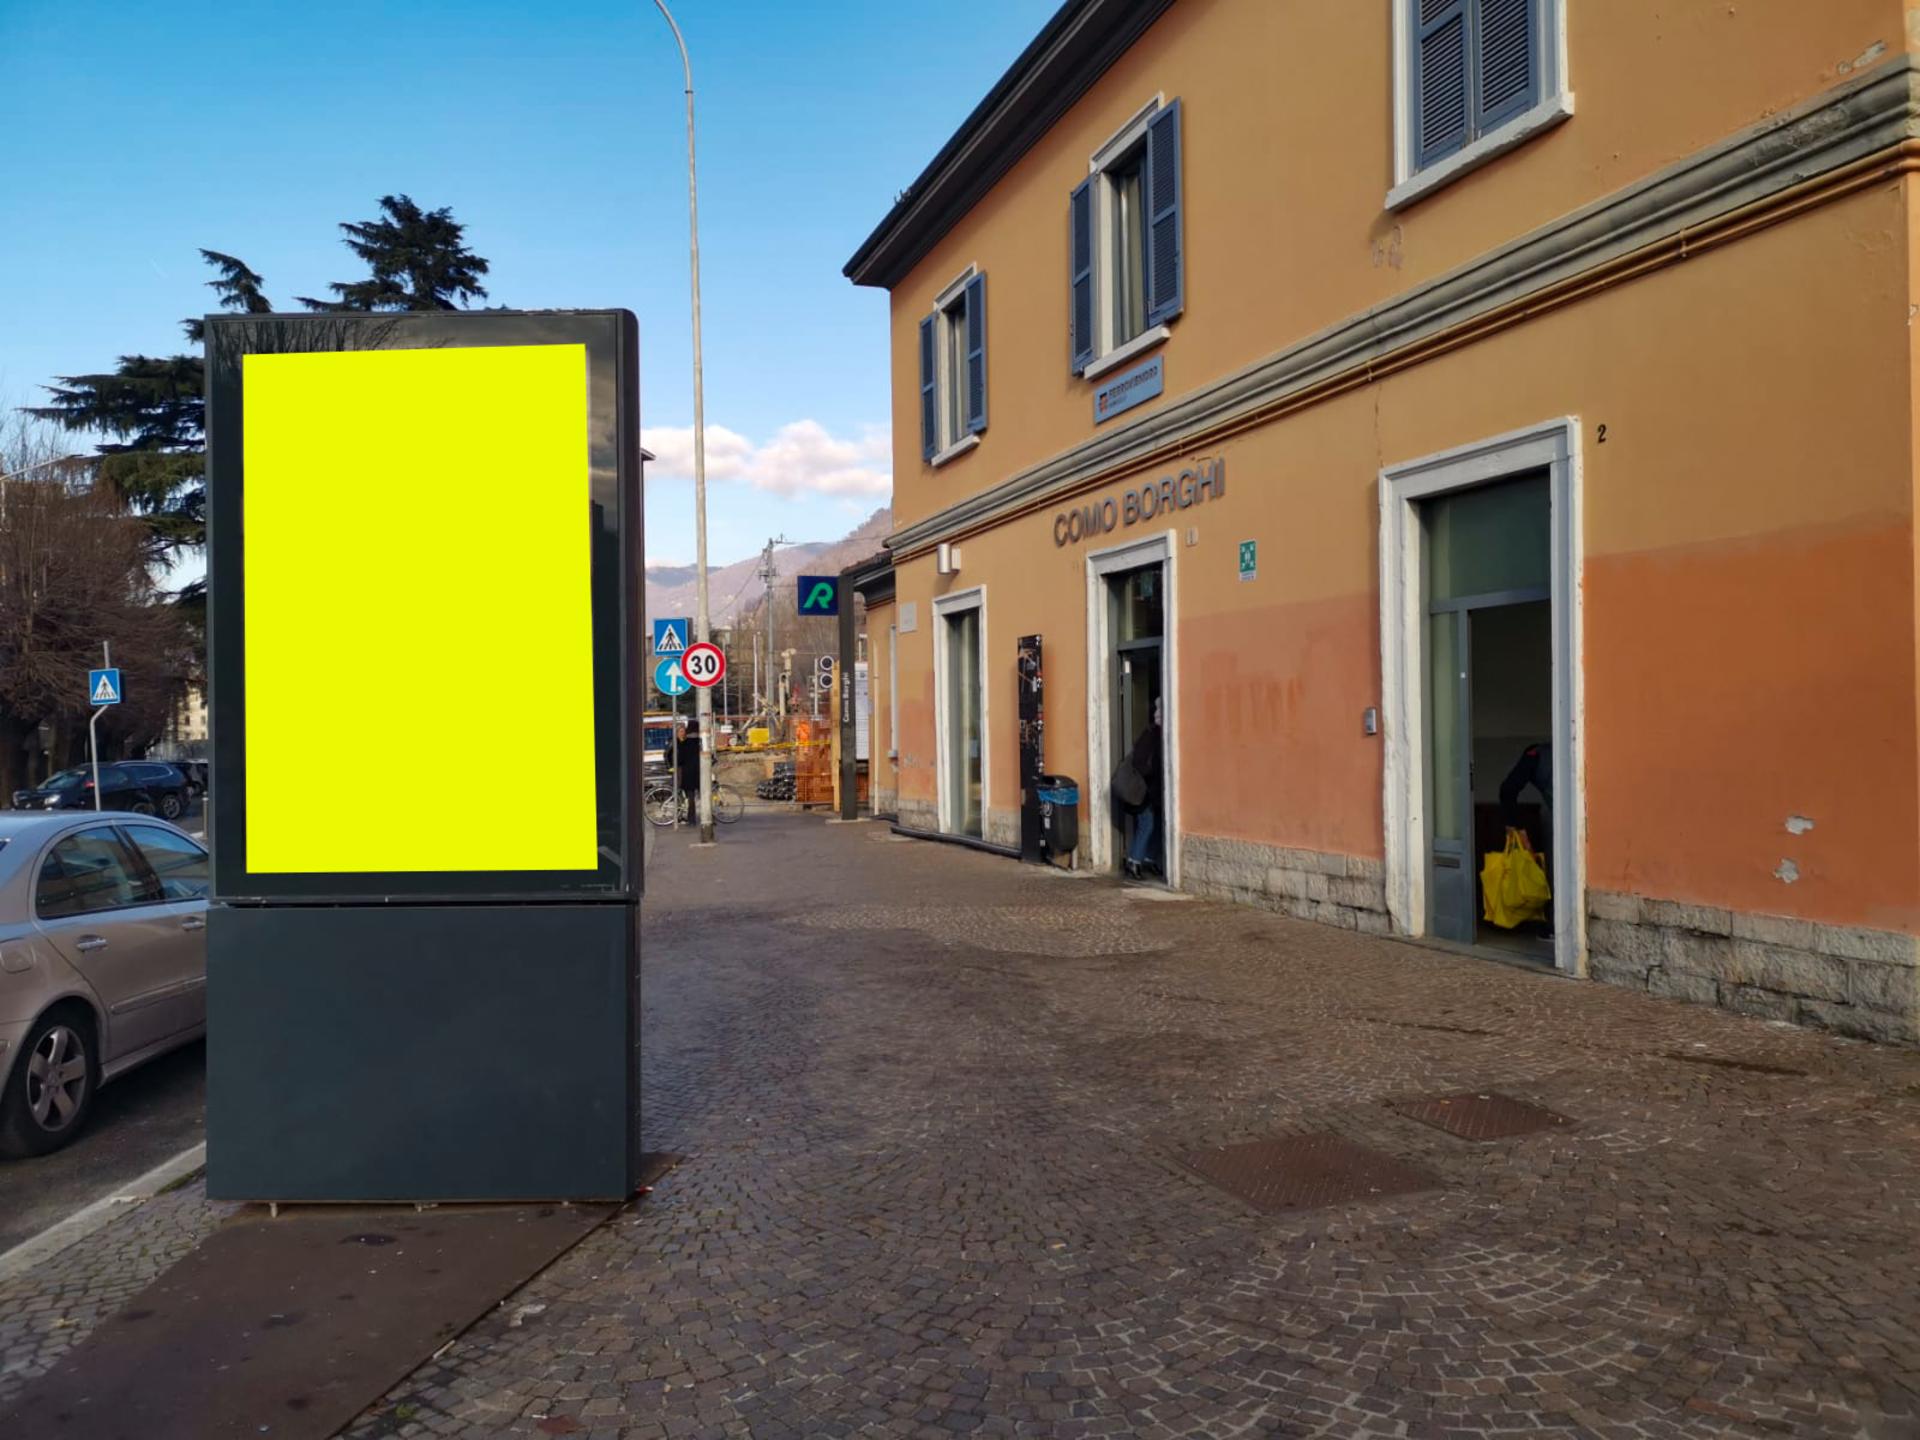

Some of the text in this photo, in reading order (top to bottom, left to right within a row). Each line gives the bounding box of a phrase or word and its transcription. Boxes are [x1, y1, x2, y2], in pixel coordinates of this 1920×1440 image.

[1597, 424, 1607, 443] 2
[1054, 456, 1226, 548] COMO BORGHI
[691, 654, 716, 675] 30
